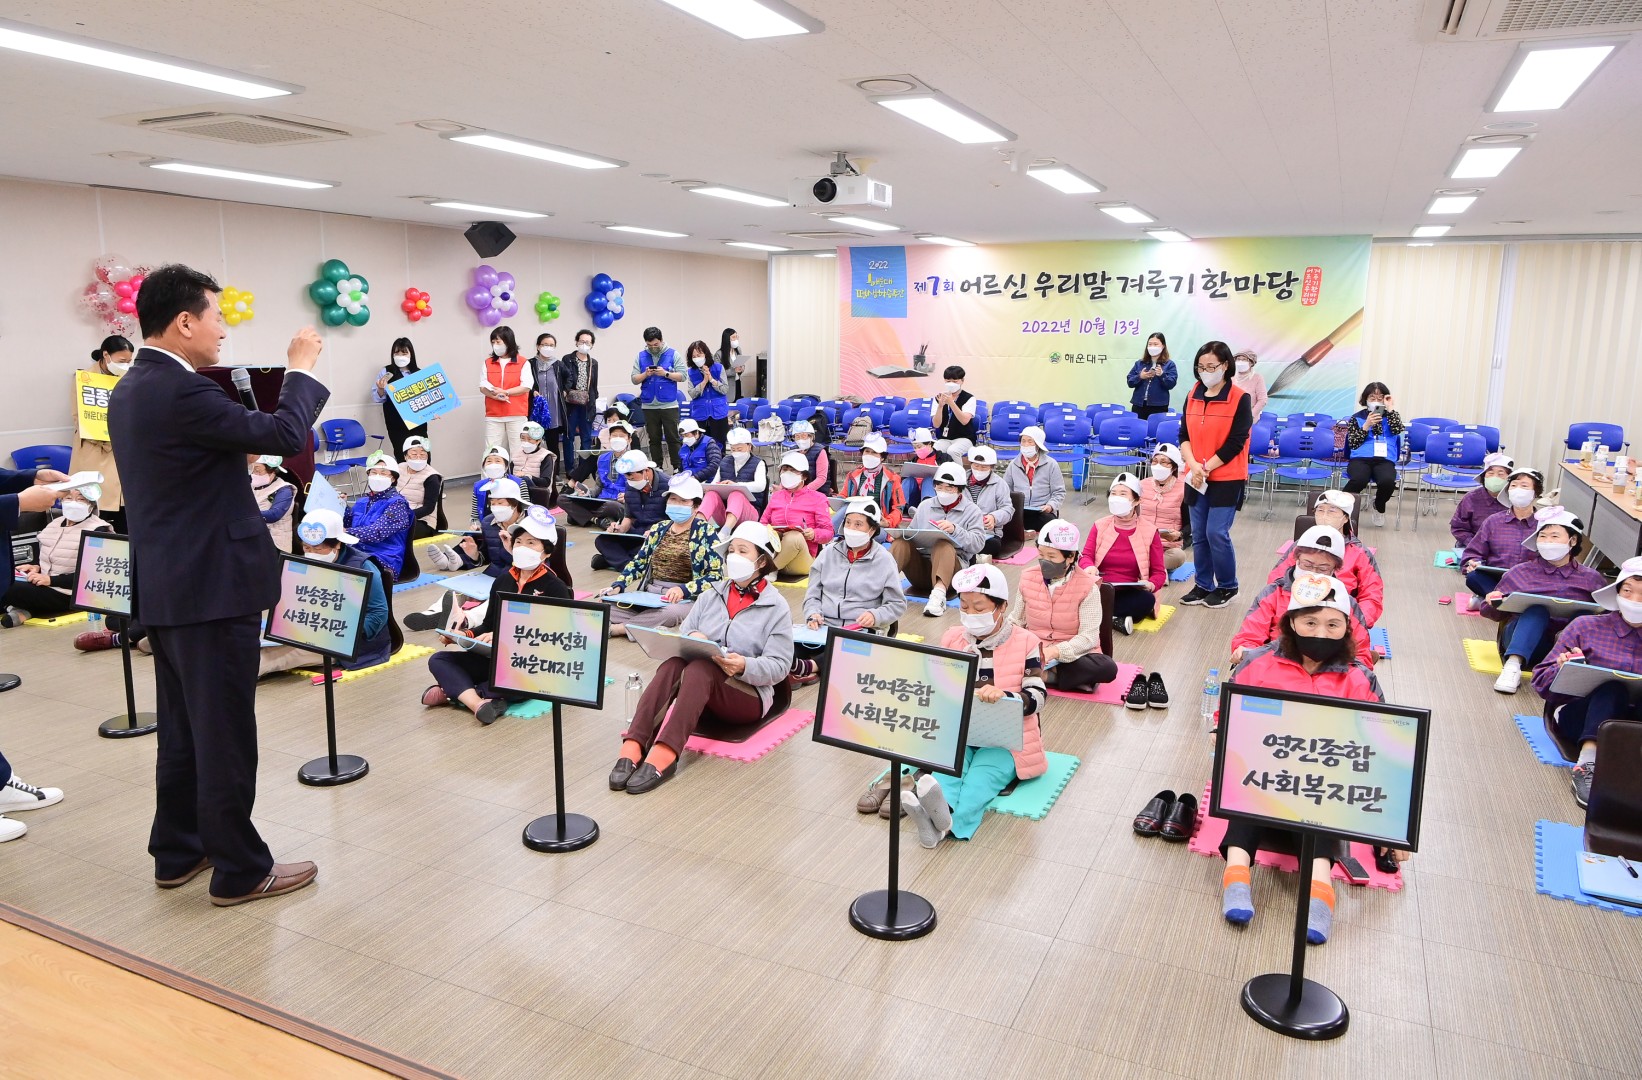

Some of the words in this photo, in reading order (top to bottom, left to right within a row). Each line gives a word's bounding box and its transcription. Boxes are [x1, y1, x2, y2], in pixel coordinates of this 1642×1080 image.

[868, 260, 889, 270] 2022
[914, 275, 954, 296] 제7회
[960, 273, 1028, 300] 어르신
[1034, 270, 1112, 300] 우리말
[1116, 269, 1195, 298] 겨루기
[1201, 268, 1300, 301] 한마당
[1022, 318, 1071, 334] 2022년
[1079, 317, 1106, 336] 10월
[1113, 319, 1140, 336] 13일
[1064, 353, 1108, 364] 해운대구
[82, 385, 113, 408] 금종
[393, 380, 428, 404] 어르신들의
[424, 372, 447, 391] 도전을
[409, 388, 446, 413] 응원합니다!
[295, 584, 346, 611] 반송종합
[282, 608, 348, 637] 사회복지관
[513, 624, 588, 651] 부산여성회
[510, 652, 585, 681] 해운대지부
[856, 672, 935, 707] 반여종합
[841, 702, 941, 740] 사회복지관
[1262, 733, 1376, 773] 영진종합
[1242, 769, 1388, 813] 사회복지관
